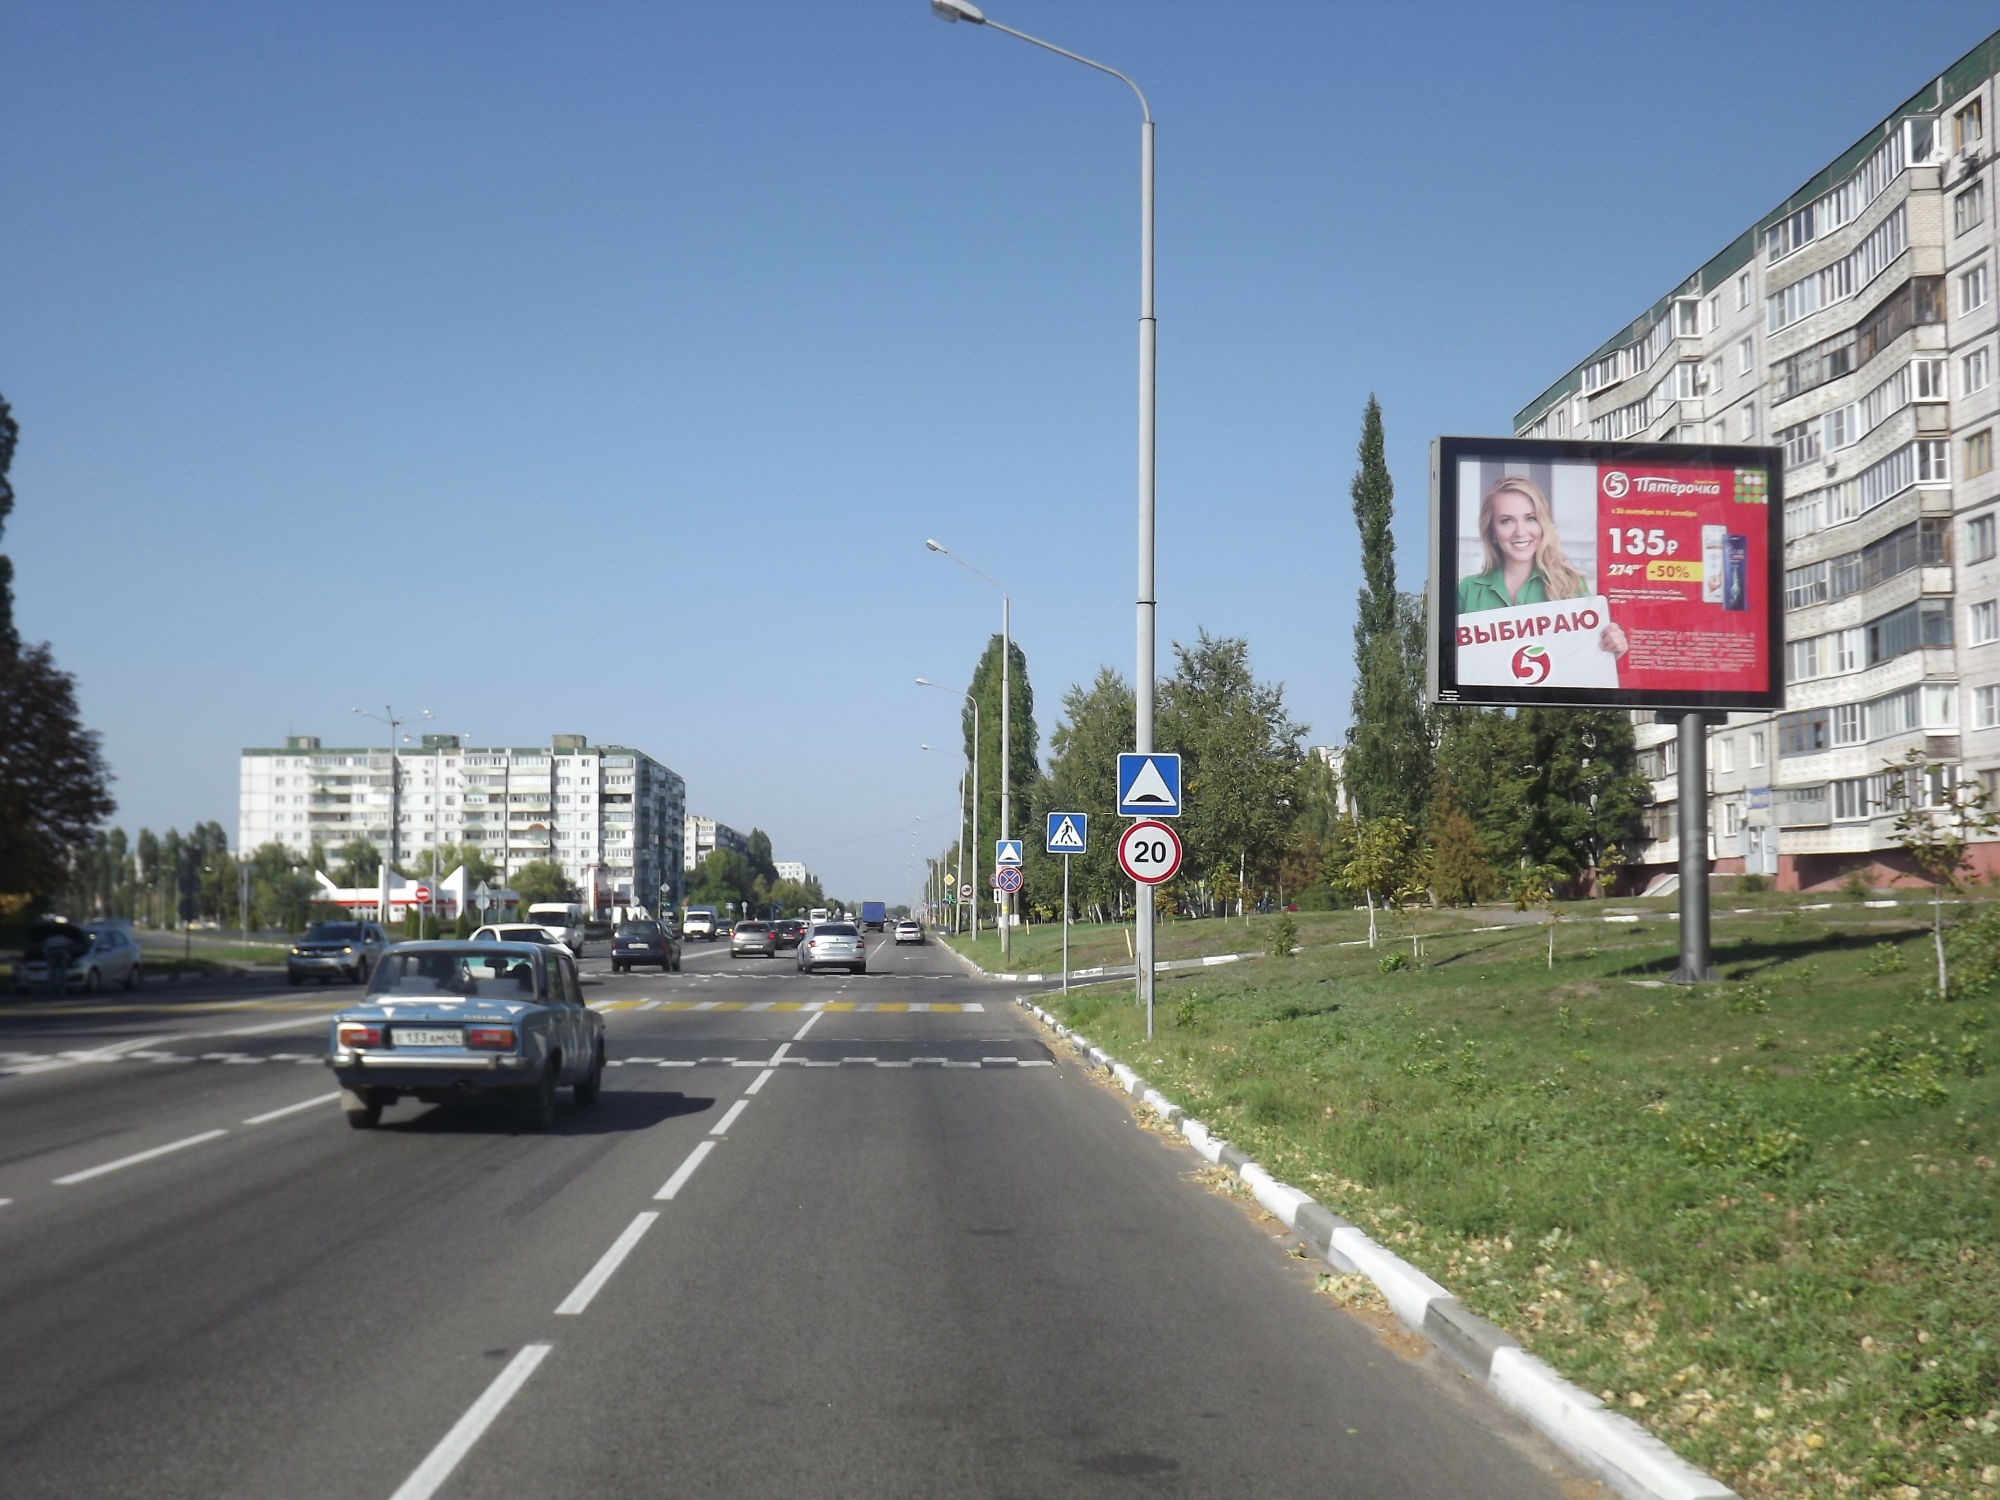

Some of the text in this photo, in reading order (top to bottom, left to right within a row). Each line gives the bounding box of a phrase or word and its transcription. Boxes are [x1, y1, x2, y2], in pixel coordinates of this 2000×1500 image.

[1633, 476, 1721, 496] Пятерочка
[1650, 565, 1690, 579] -50%
[1456, 609, 1600, 647] ВЫБИРАЮ
[1134, 841, 1166, 863] 20
